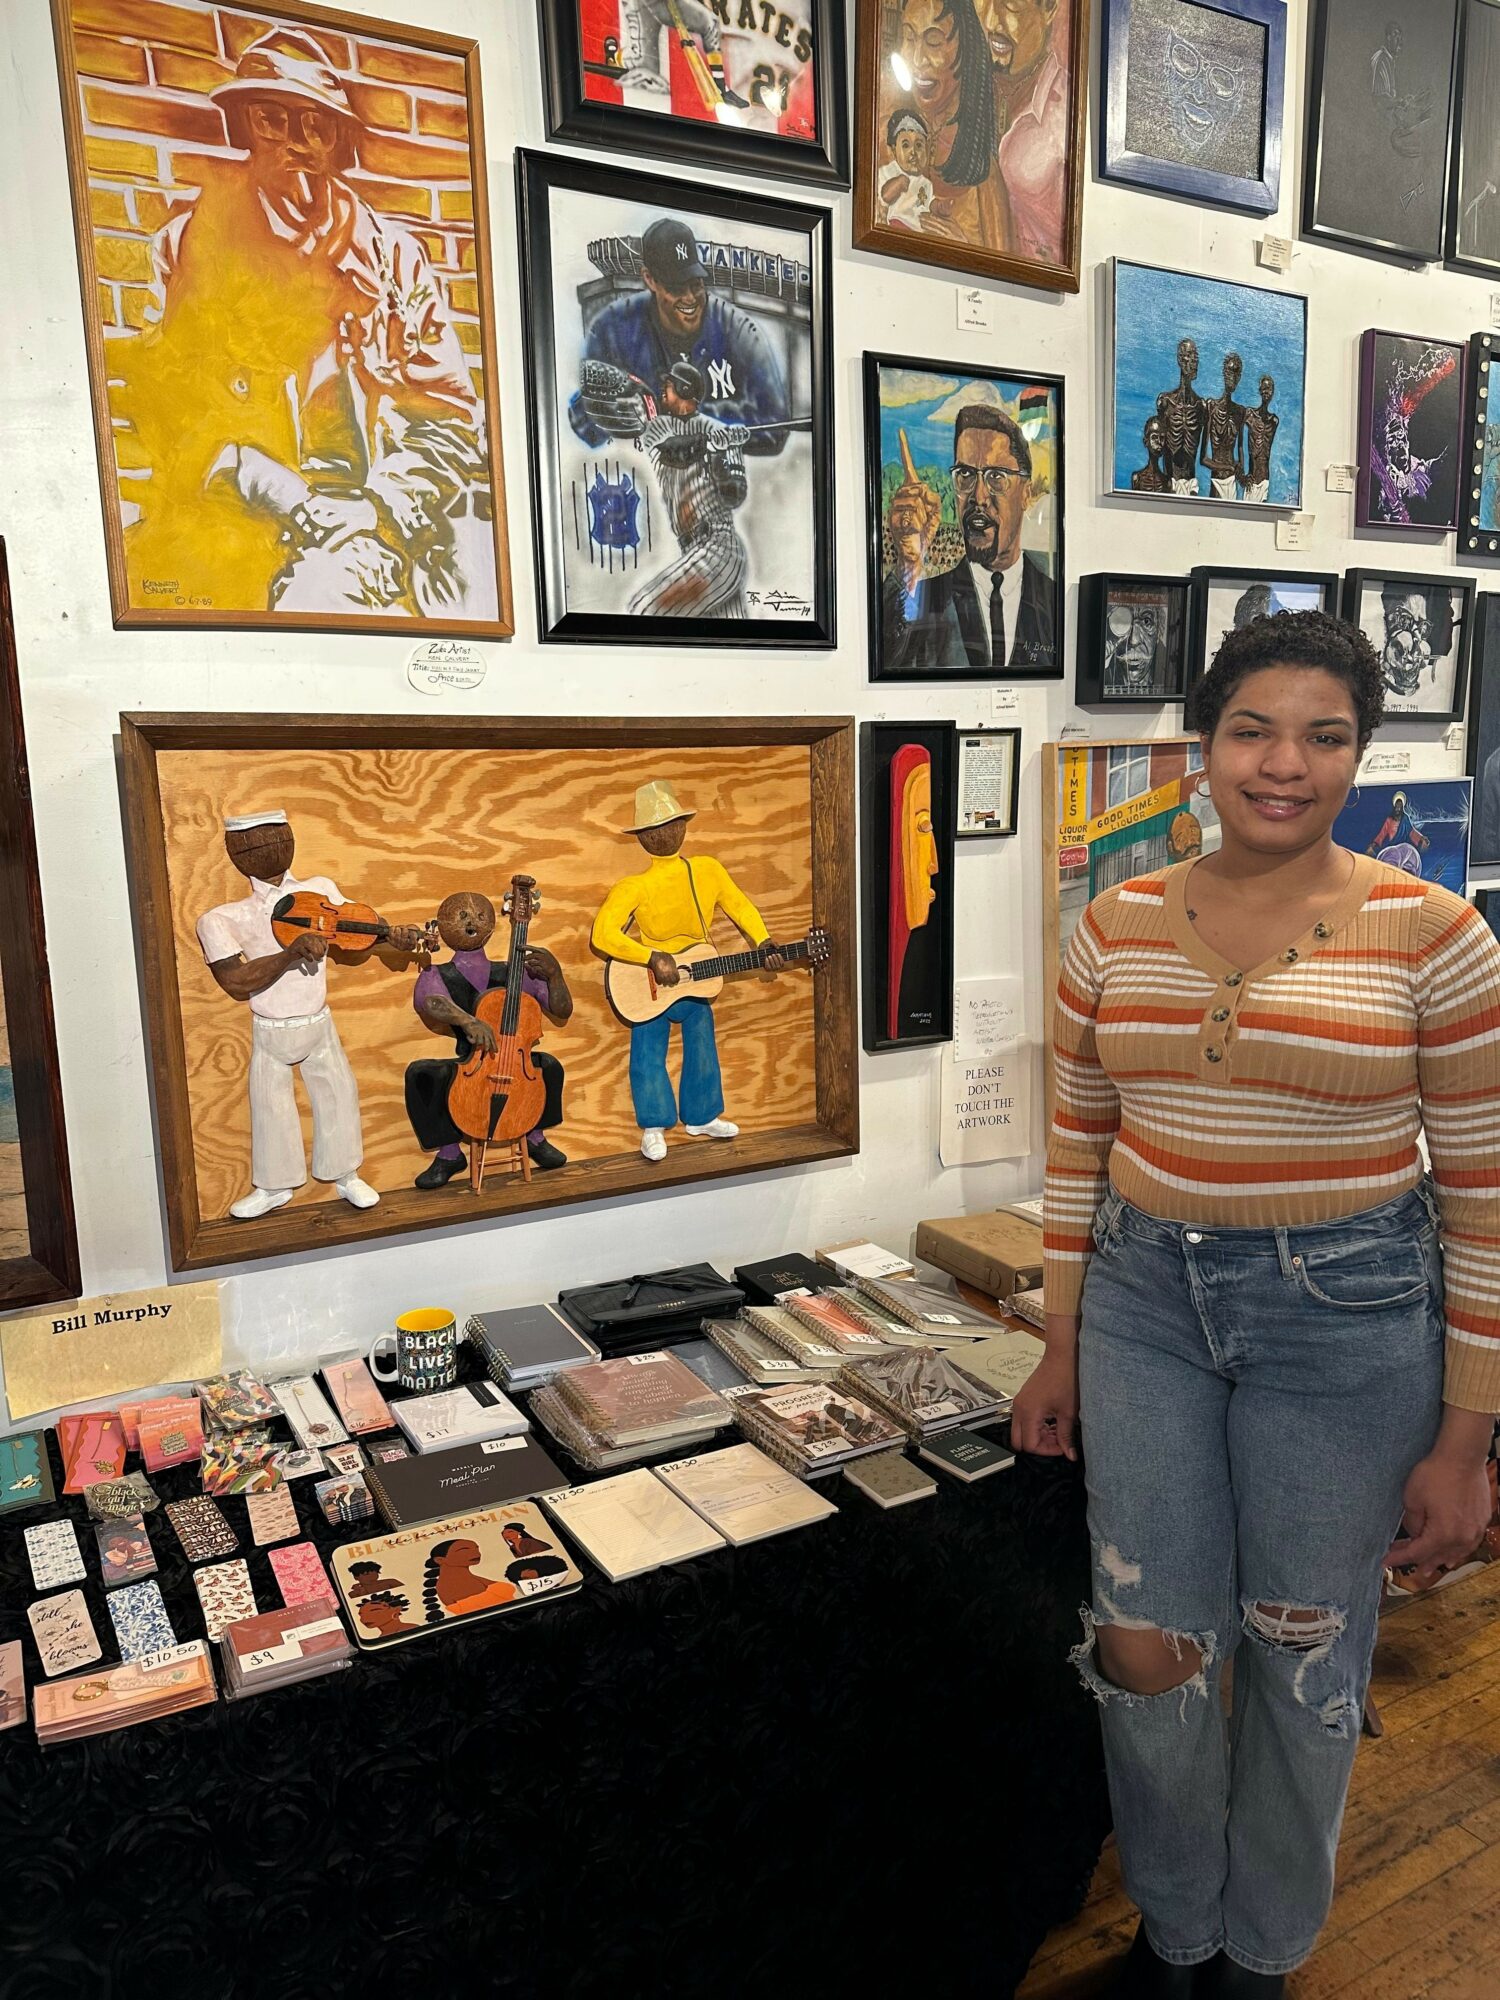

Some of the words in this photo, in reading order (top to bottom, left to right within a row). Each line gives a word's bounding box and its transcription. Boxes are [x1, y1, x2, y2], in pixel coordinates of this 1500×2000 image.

[1097, 811, 1124, 829] GOOD
[1128, 794, 1160, 813] TIMES
[1110, 811, 1146, 831] LIQUOR
[1059, 825, 1088, 834] LIQUOR
[1062, 834, 1085, 843] STORE
[965, 1066, 1005, 1080] PLEASE
[968, 1082, 1001, 1096] DON'T
[955, 1100, 991, 1114] TOUCH
[993, 1097, 1015, 1108] THE
[956, 1113, 1011, 1130] ARTWORK
[52, 1315, 87, 1334] Bill
[94, 1303, 172, 1326] Murphy
[405, 1328, 455, 1350] BLACK
[409, 1350, 453, 1370] LIVES
[767, 1360, 788, 1369] $32
[772, 1391, 828, 1408] PROGRESS
[426, 1428, 450, 1439] $17
[487, 1442, 506, 1450] $10
[817, 1440, 837, 1452] $23
[954, 1447, 976, 1459] COFFEE
[338, 1454, 354, 1462] SLAY
[960, 1448, 990, 1462] SUNSHINE
[343, 1463, 360, 1471] SLAY
[440, 1471, 470, 1488] Meal
[471, 1464, 496, 1476] Plan
[110, 1484, 138, 1496] black
[106, 1494, 126, 1505] girl
[106, 1501, 140, 1514] magic
[527, 1578, 553, 1592] $15
[36, 1609, 62, 1624] still
[64, 1619, 84, 1633] she
[49, 1642, 89, 1661] blooms
[250, 1650, 275, 1667] $9
